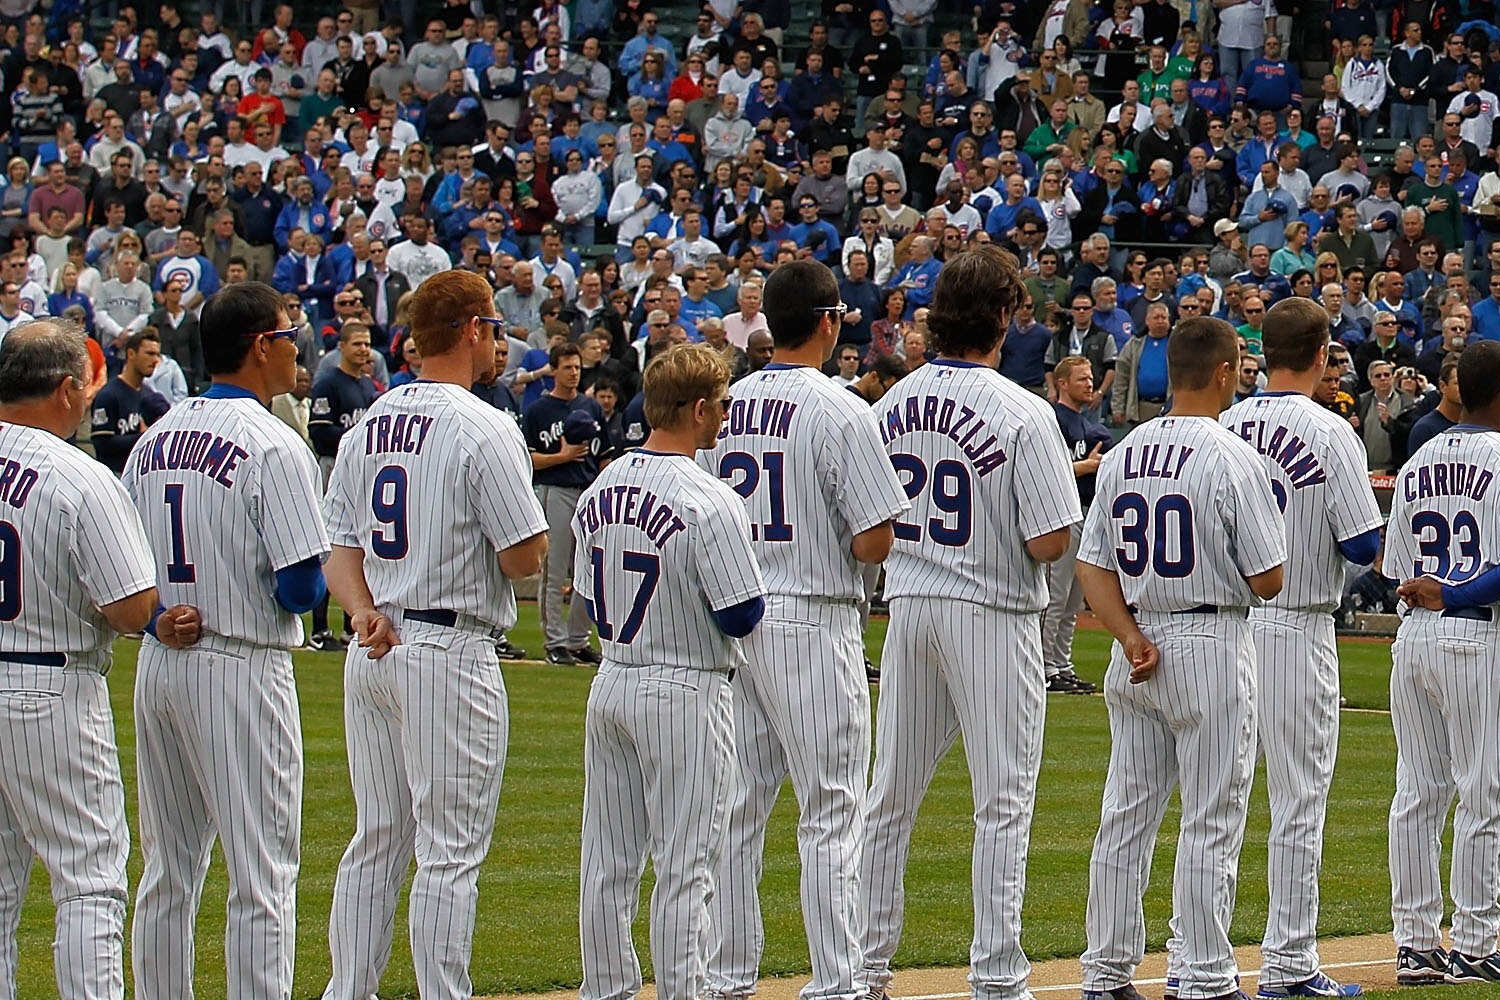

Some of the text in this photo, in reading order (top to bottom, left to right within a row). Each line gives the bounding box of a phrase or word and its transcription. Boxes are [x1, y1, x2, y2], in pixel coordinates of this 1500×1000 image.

[136, 431, 249, 489] FUKUDOME
[365, 414, 433, 456] TRACY
[1124, 444, 1194, 480] LILLY
[372, 466, 409, 560] 9
[577, 485, 686, 550] FONTENOT
[720, 452, 793, 542] 21
[889, 453, 973, 548] 29
[1404, 463, 1493, 502] CARIDAD
[164, 484, 196, 583] 1
[1112, 491, 1196, 579] 30
[1412, 510, 1482, 581] 33
[591, 546, 661, 645] 17
